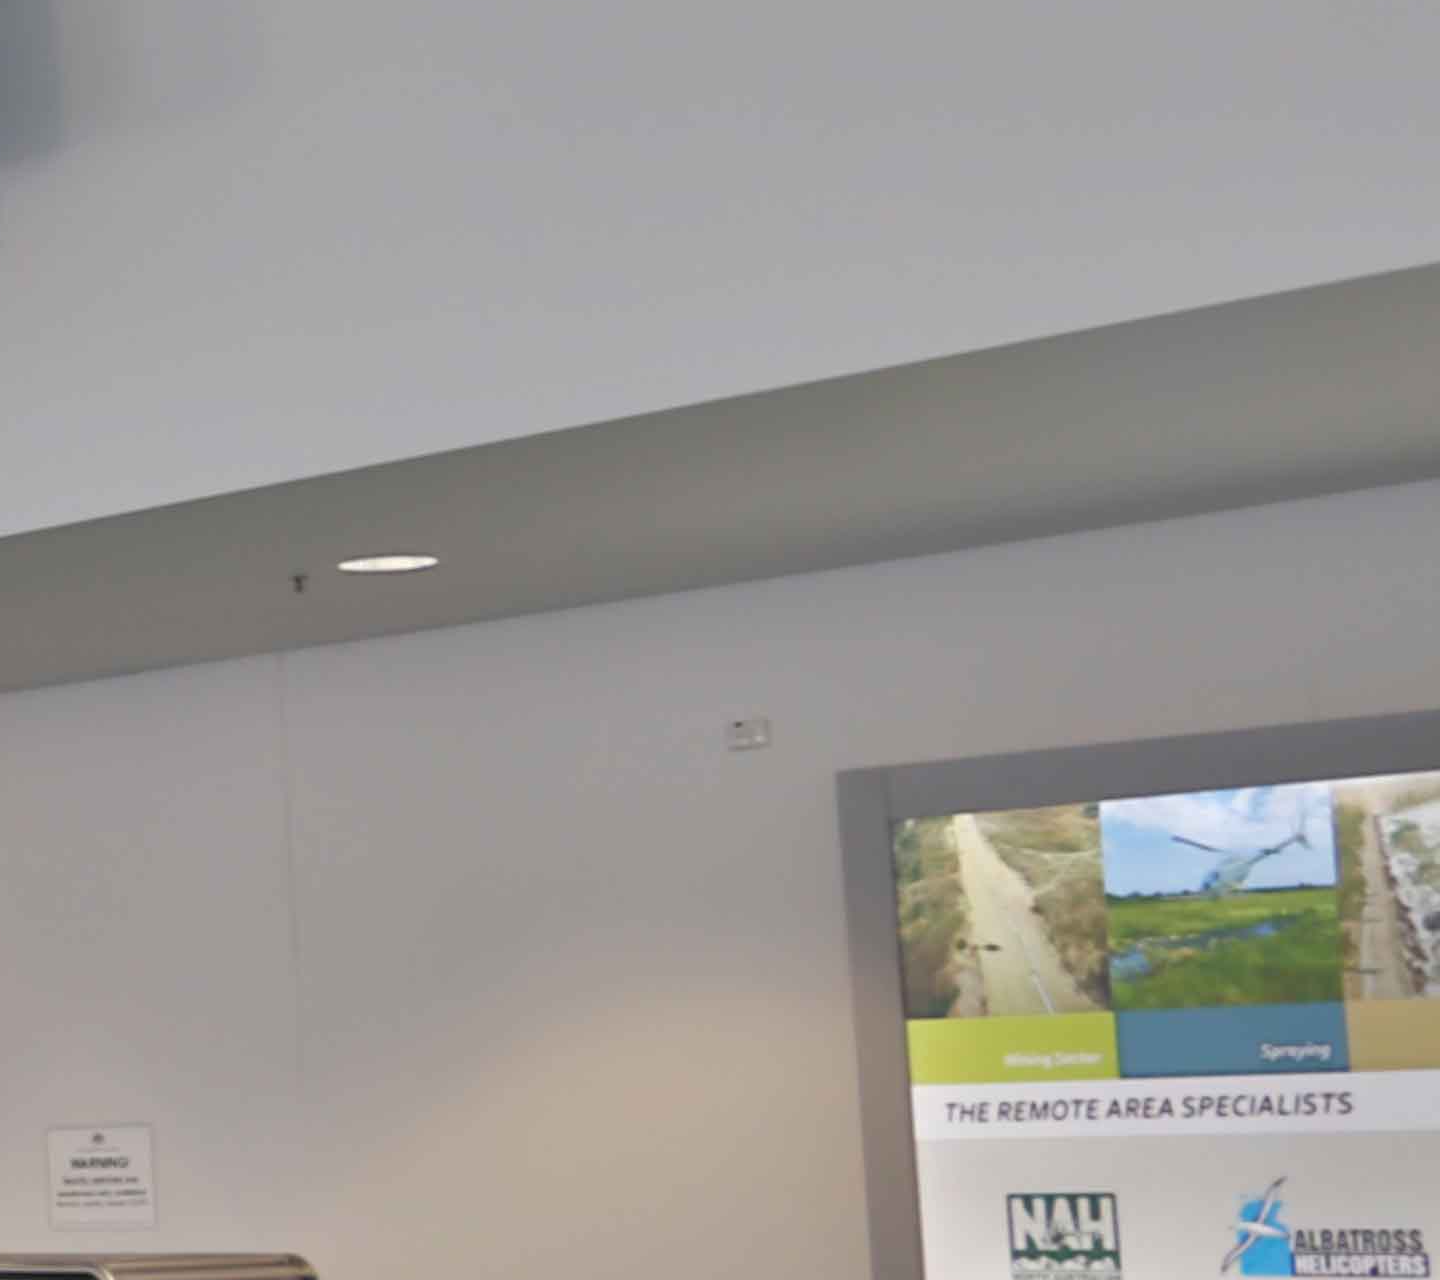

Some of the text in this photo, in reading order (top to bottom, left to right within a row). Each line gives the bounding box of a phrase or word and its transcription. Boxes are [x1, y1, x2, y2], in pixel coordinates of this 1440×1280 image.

[1260, 1042, 1332, 1062] Spraying
[945, 1091, 1354, 1124] THE REMOTE AREA SPECIALISTS
[1009, 1196, 1119, 1252] NAH
[1294, 1228, 1426, 1252] ALBATROSS
[1295, 1254, 1427, 1275] HELICOPTERS
